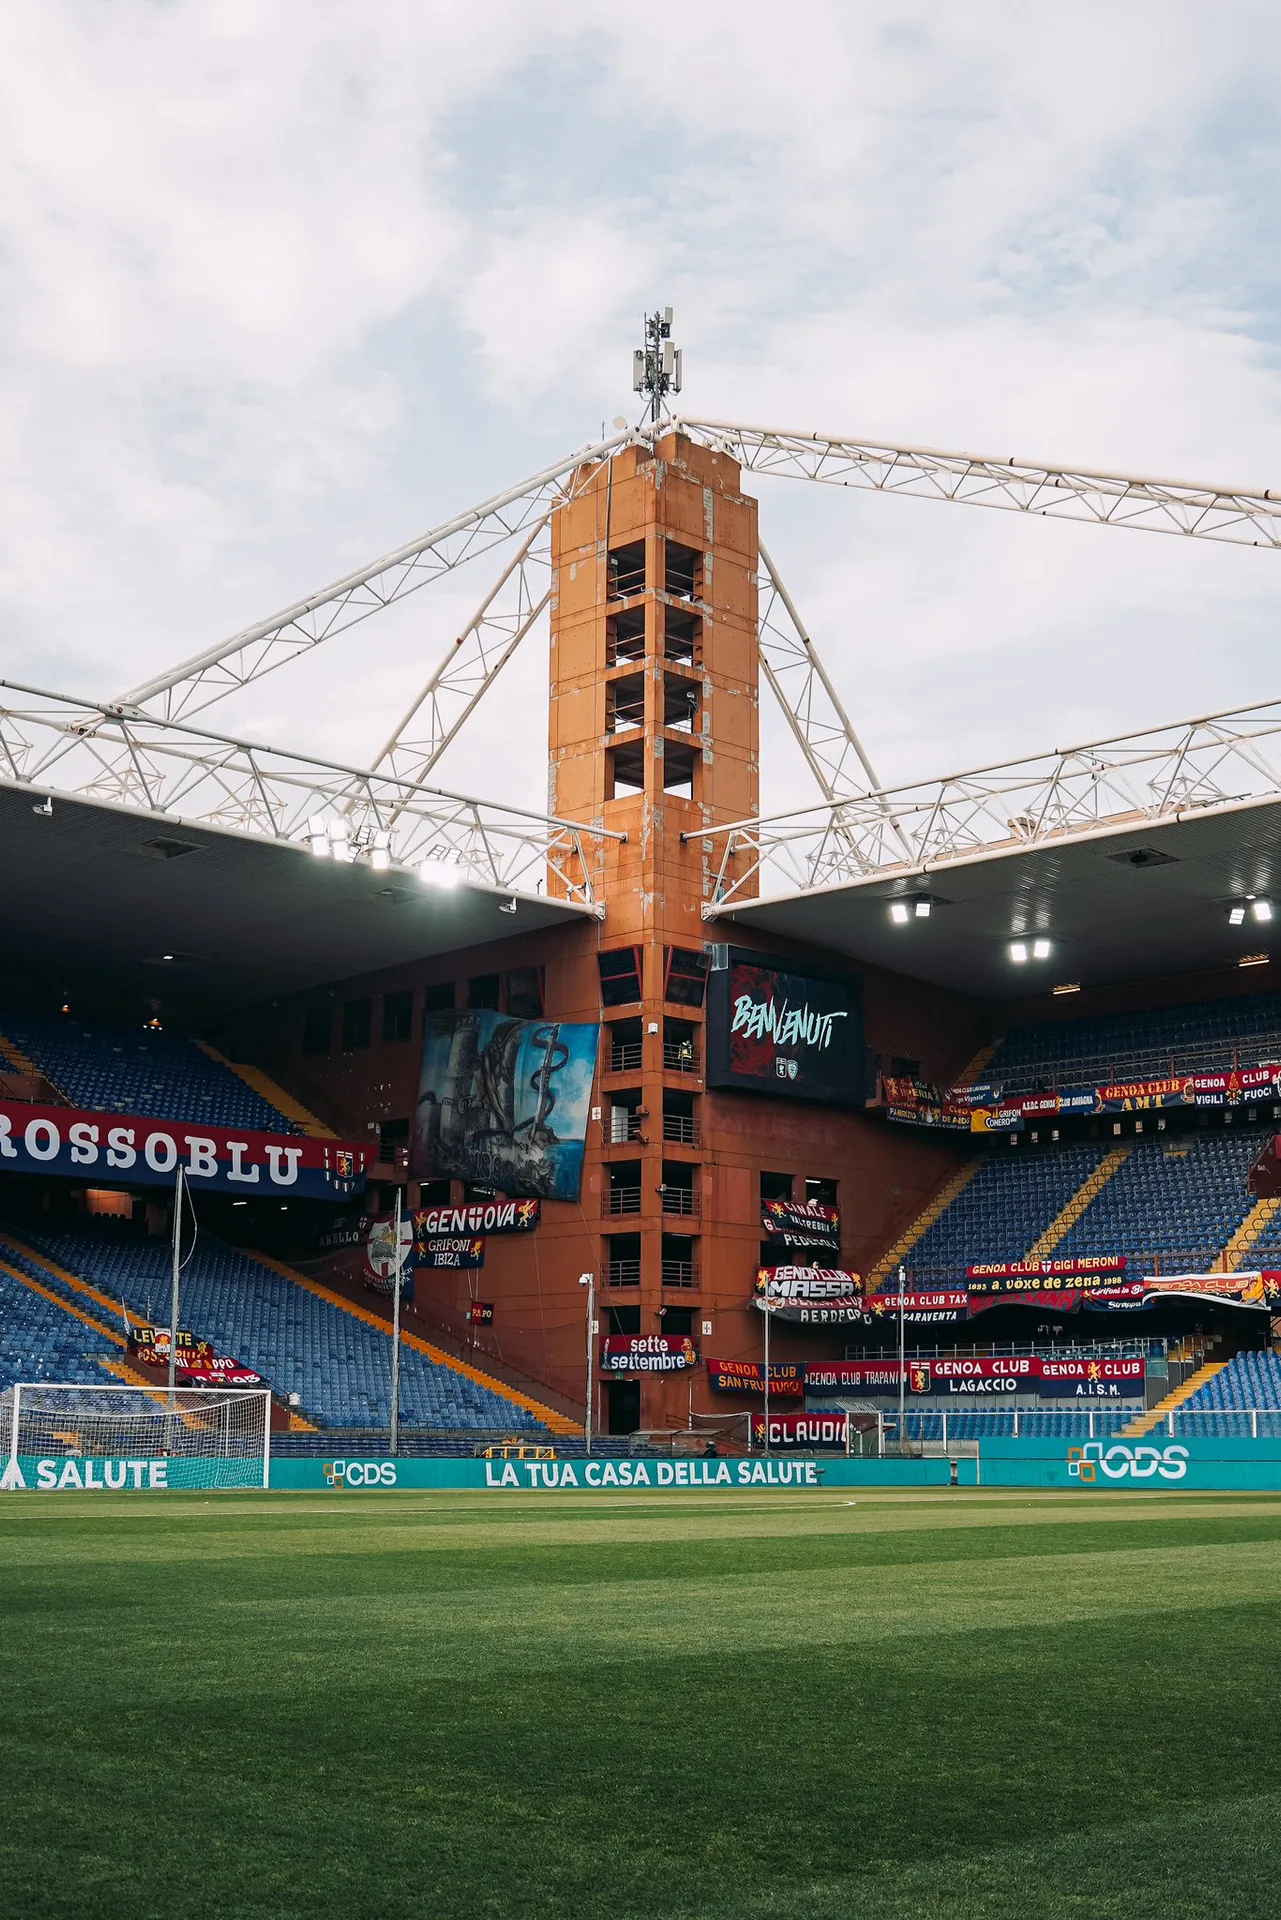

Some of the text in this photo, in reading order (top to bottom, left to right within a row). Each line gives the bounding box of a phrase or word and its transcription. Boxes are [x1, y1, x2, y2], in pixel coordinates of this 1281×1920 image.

[1195, 1070, 1270, 1089] GENOA CLUB
[1105, 1079, 1180, 1099] GENOA CLUB
[1121, 1094, 1165, 1111] AMT
[1195, 1094, 1224, 1105] VIGILI
[942, 1115, 952, 1123] DE
[986, 1117, 1011, 1128] CONERO
[784, 1202, 827, 1219] CANALE
[790, 1214, 831, 1233] VALTREBBIA
[428, 1239, 472, 1252] GRIFONI
[434, 1253, 461, 1266] IBIZA
[973, 1256, 1119, 1275] GENOA CLUB GIGI MERONI
[773, 1265, 853, 1282] GENOA CLUB
[1043, 1275, 1062, 1289] de
[1065, 1275, 1100, 1288] zena
[768, 1280, 854, 1297] MASSA
[1204, 1279, 1250, 1289] CLUB
[920, 1294, 945, 1305] CLUB
[630, 1335, 669, 1352] sette
[611, 1352, 686, 1371] settembre
[719, 1361, 797, 1378] GENOA CLUB
[935, 1360, 1030, 1375] GENOA CLUB
[1043, 1362, 1141, 1376] GENOA CLUB
[718, 1375, 741, 1388] SAN
[809, 1370, 899, 1386] GENOA CLUB TRAPANI
[949, 1378, 1018, 1393] LAGACCIO
[1100, 1445, 1190, 1480] CDS
[37, 1460, 168, 1489] SALUTE
[346, 1462, 398, 1486] CDS
[485, 1461, 818, 1487] LA TUA CASA DELLA SALUTE
